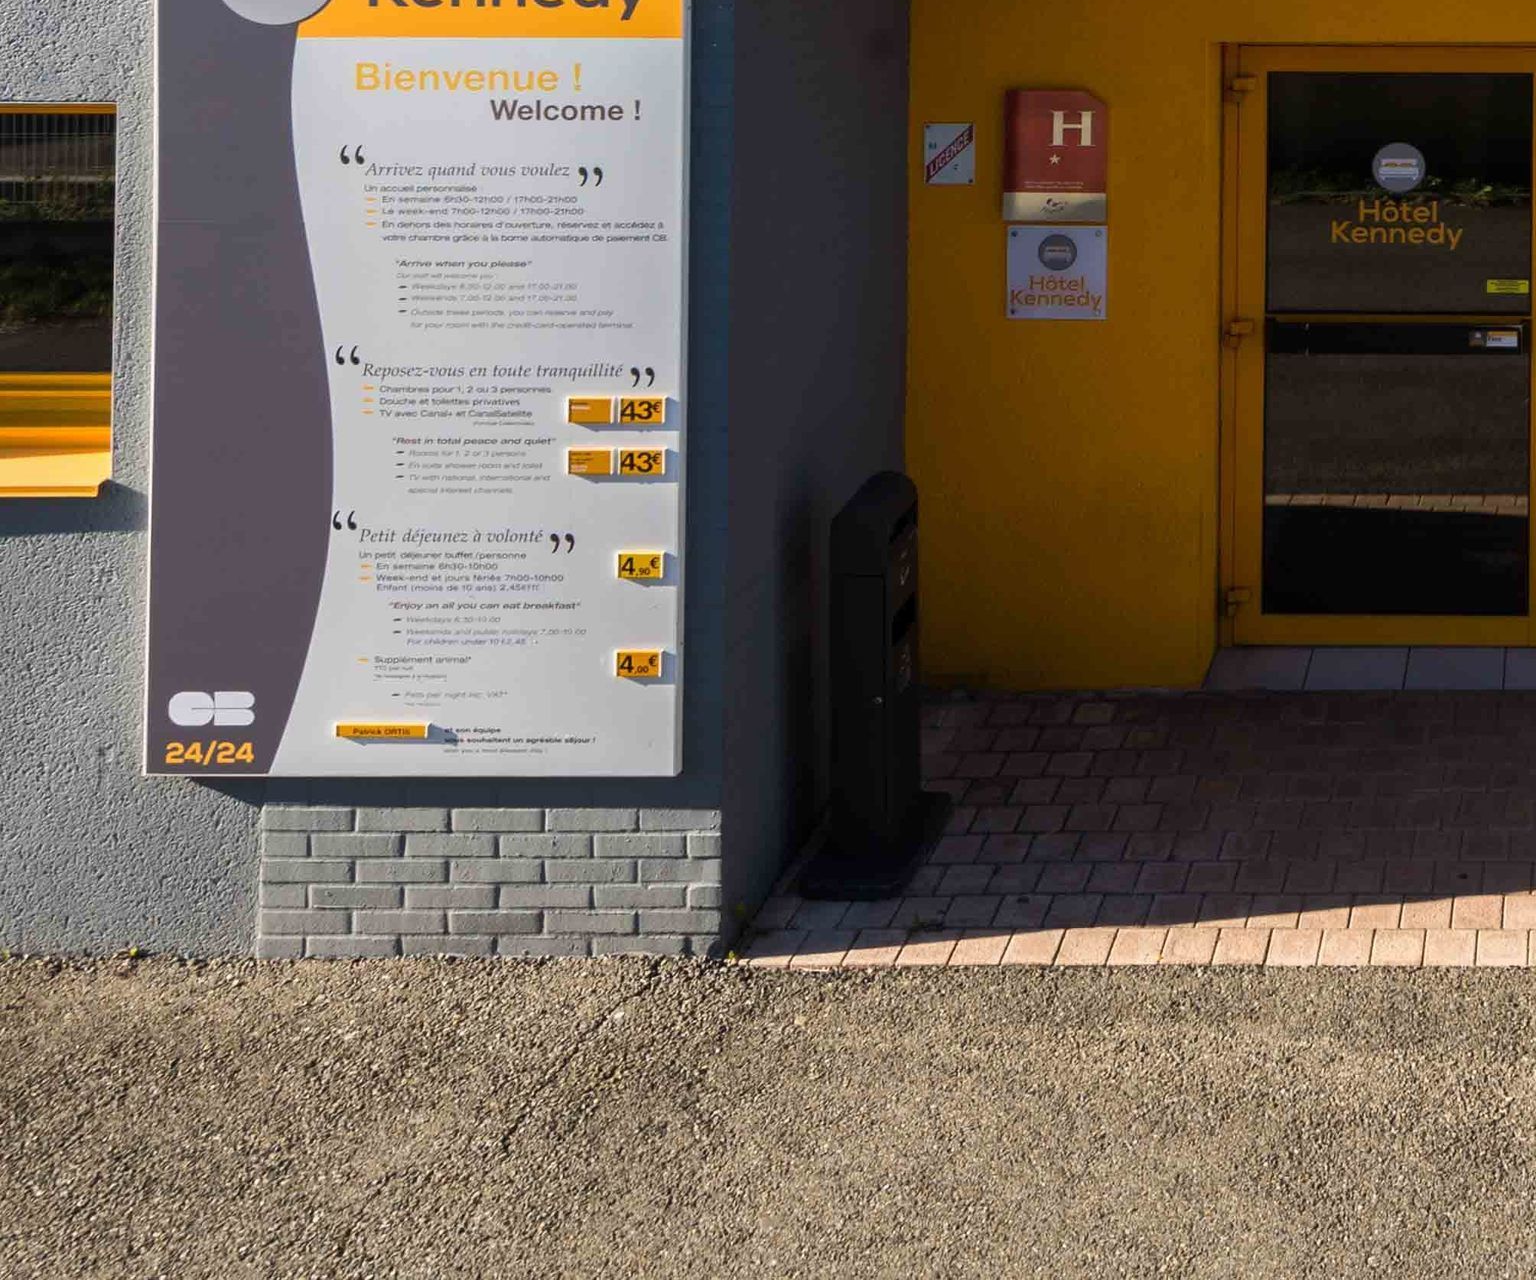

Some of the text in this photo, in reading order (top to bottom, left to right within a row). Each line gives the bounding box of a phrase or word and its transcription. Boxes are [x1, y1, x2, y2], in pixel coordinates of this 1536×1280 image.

[355, 62, 582, 92] Bienvenue !
[490, 99, 642, 121] Welcome !
[1051, 110, 1096, 147] H
[929, 130, 973, 176] LICENCE
[364, 163, 570, 180] Arrivez quand vous voulez
[1358, 199, 1439, 223] Hôtel
[1330, 220, 1464, 250] Kennedy
[1029, 275, 1087, 291] Hôtel
[1010, 290, 1103, 312] Kennedy
[363, 362, 624, 381] Reposez-vous en toute tranquillité
[621, 400, 662, 421] 43€
[621, 452, 662, 473] 43€
[359, 529, 544, 547] Petit déjeunez à volonté
[165, 740, 255, 766] 24/24
